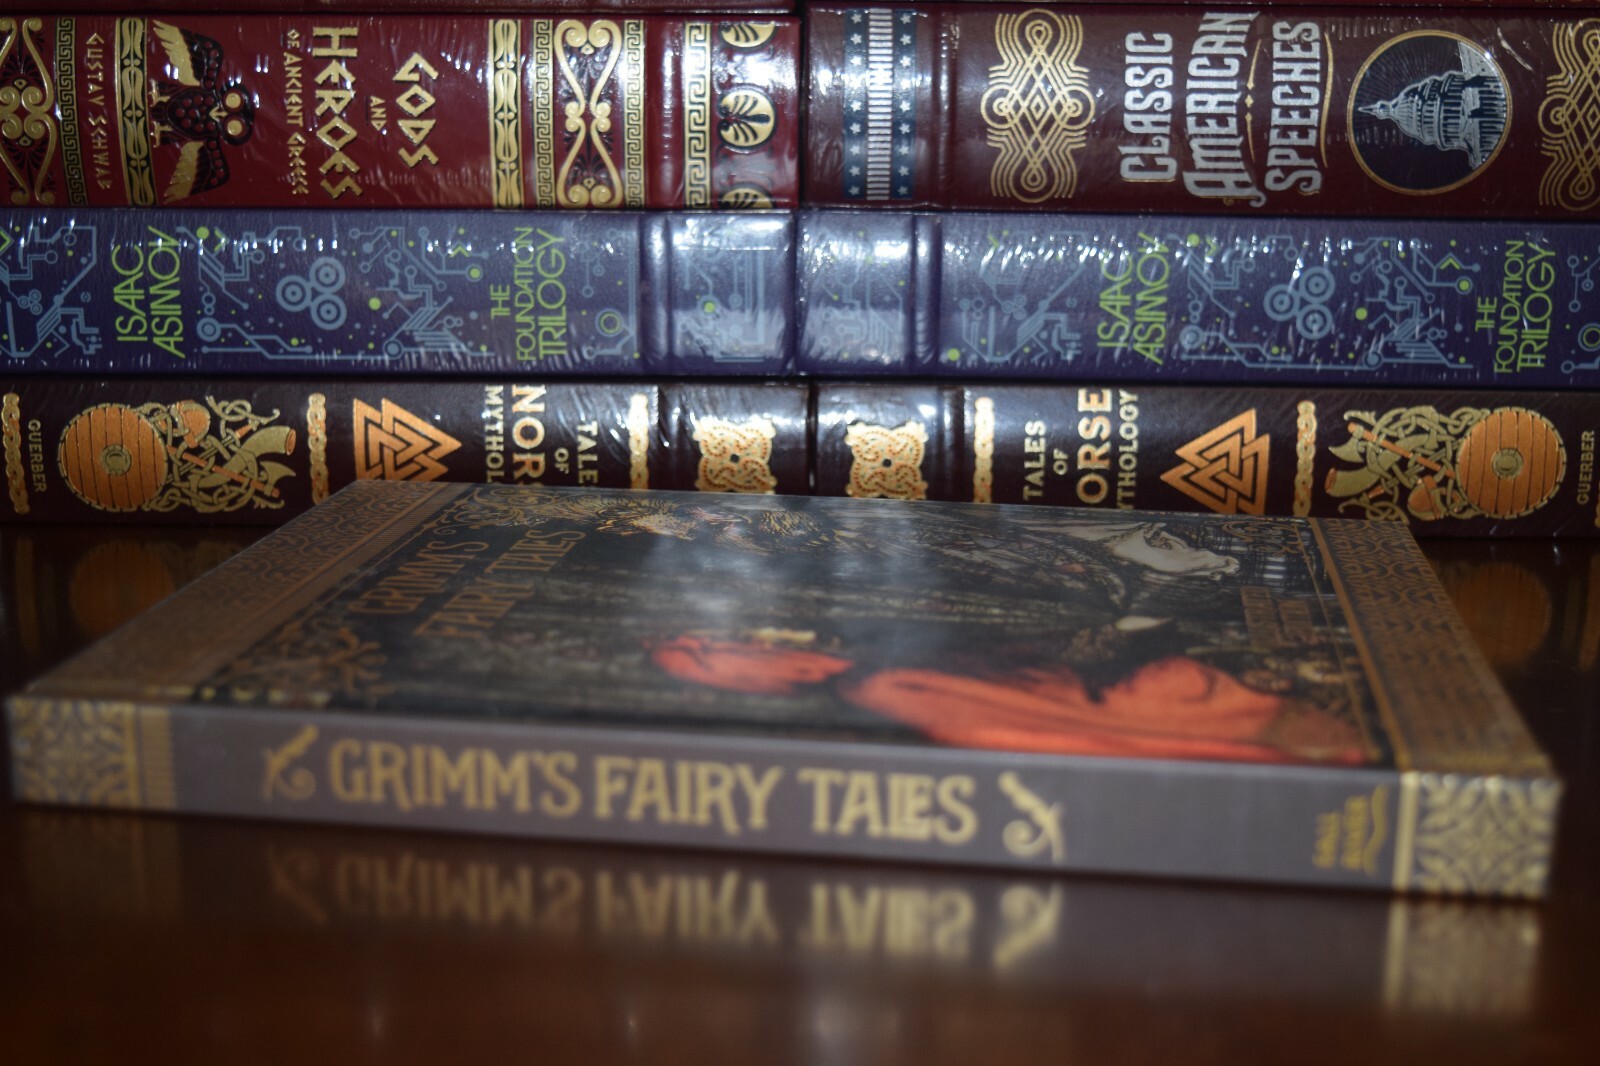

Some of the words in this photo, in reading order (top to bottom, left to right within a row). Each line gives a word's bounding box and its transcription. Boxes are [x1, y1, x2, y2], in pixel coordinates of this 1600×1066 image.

[86, 32, 105, 106] GUSTAV
[283, 51, 303, 127] ANCIENT
[286, 28, 300, 49] OF
[88, 114, 112, 189] SCHWAB
[312, 26, 363, 199] HEROES
[369, 95, 387, 131] AND
[393, 52, 439, 168] GODS
[1119, 32, 1178, 182] CLASSIC
[1183, 11, 1266, 208] AMERICAN
[1264, 20, 1323, 195] SPEECHES
[287, 132, 309, 194] GREECE
[112, 244, 148, 342] ISAAC
[147, 225, 186, 358] ASIMOV
[489, 283, 511, 320] THE
[514, 226, 536, 361] FOUNDATION
[536, 228, 567, 360] TRILOGY
[1097, 245, 1132, 348] ISAAC
[1132, 231, 1170, 365] ASIMOV
[1475, 296, 1497, 331] THE
[1493, 240, 1525, 373] FOUNDATION
[1516, 241, 1556, 372] TRILOGY
[28, 419, 47, 492] GUERBER
[484, 384, 504, 485] MYTHOL
[511, 384, 547, 487] NOR
[554, 447, 569, 474] OF
[576, 420, 598, 487] TALE
[1023, 420, 1046, 500] TALES
[1053, 447, 1068, 475] OF
[1076, 388, 1112, 504] ORSE
[1117, 389, 1139, 510] THOLOGY
[1576, 430, 1595, 505] GUERBER
[347, 541, 489, 616] GRIMM'S
[413, 576, 536, 638] FAIRY
[483, 530, 587, 573] TALES
[328, 738, 581, 818] GRIMM'S
[592, 754, 784, 836] FAIRY
[796, 766, 979, 846] TALES
